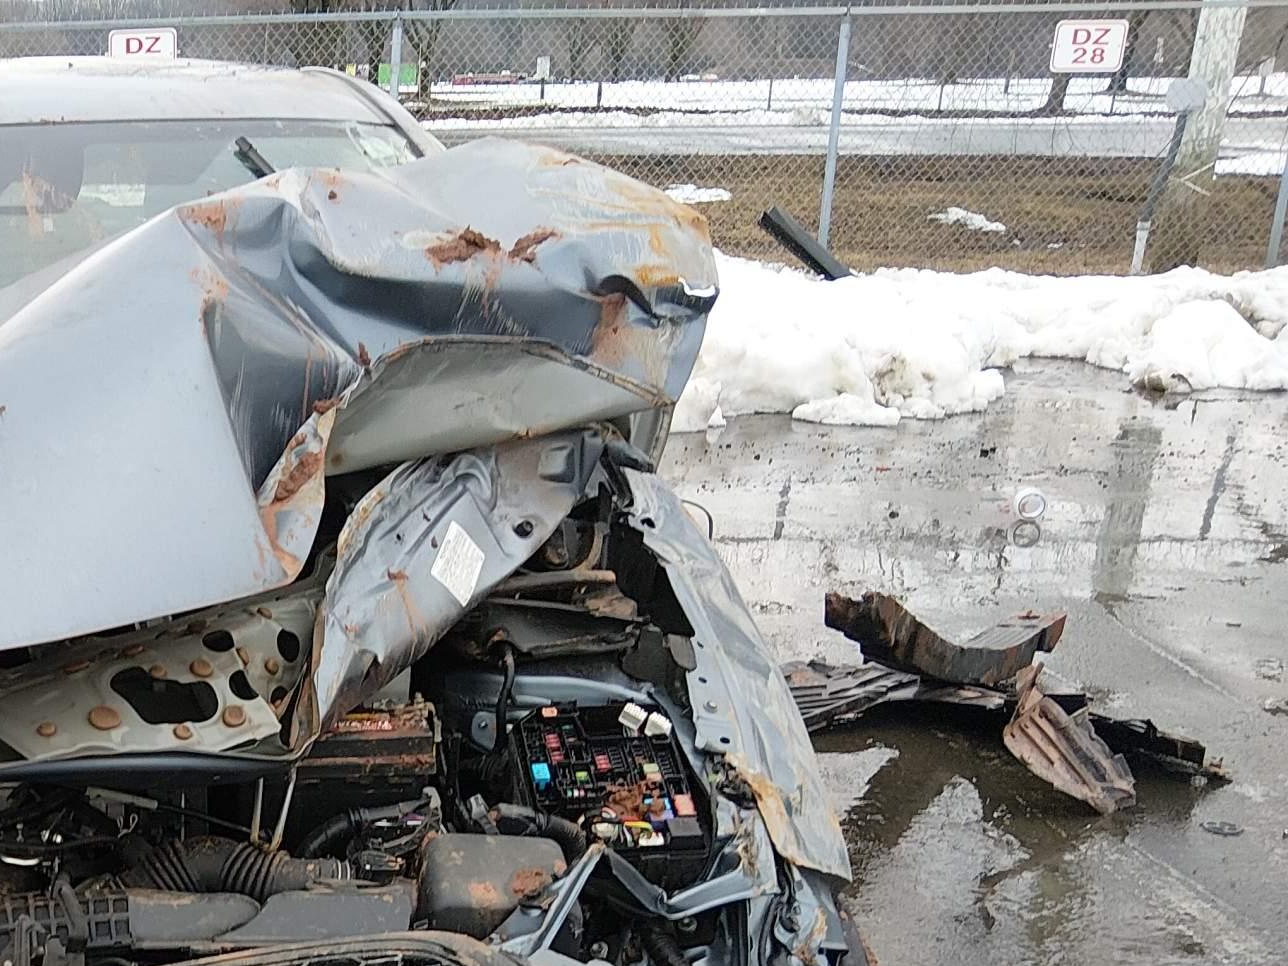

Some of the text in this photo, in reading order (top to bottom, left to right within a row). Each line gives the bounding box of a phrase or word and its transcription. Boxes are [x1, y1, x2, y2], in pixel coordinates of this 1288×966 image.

[125, 37, 161, 54] DZ
[1072, 28, 1111, 46] DZ
[1072, 48, 1105, 64] 28
